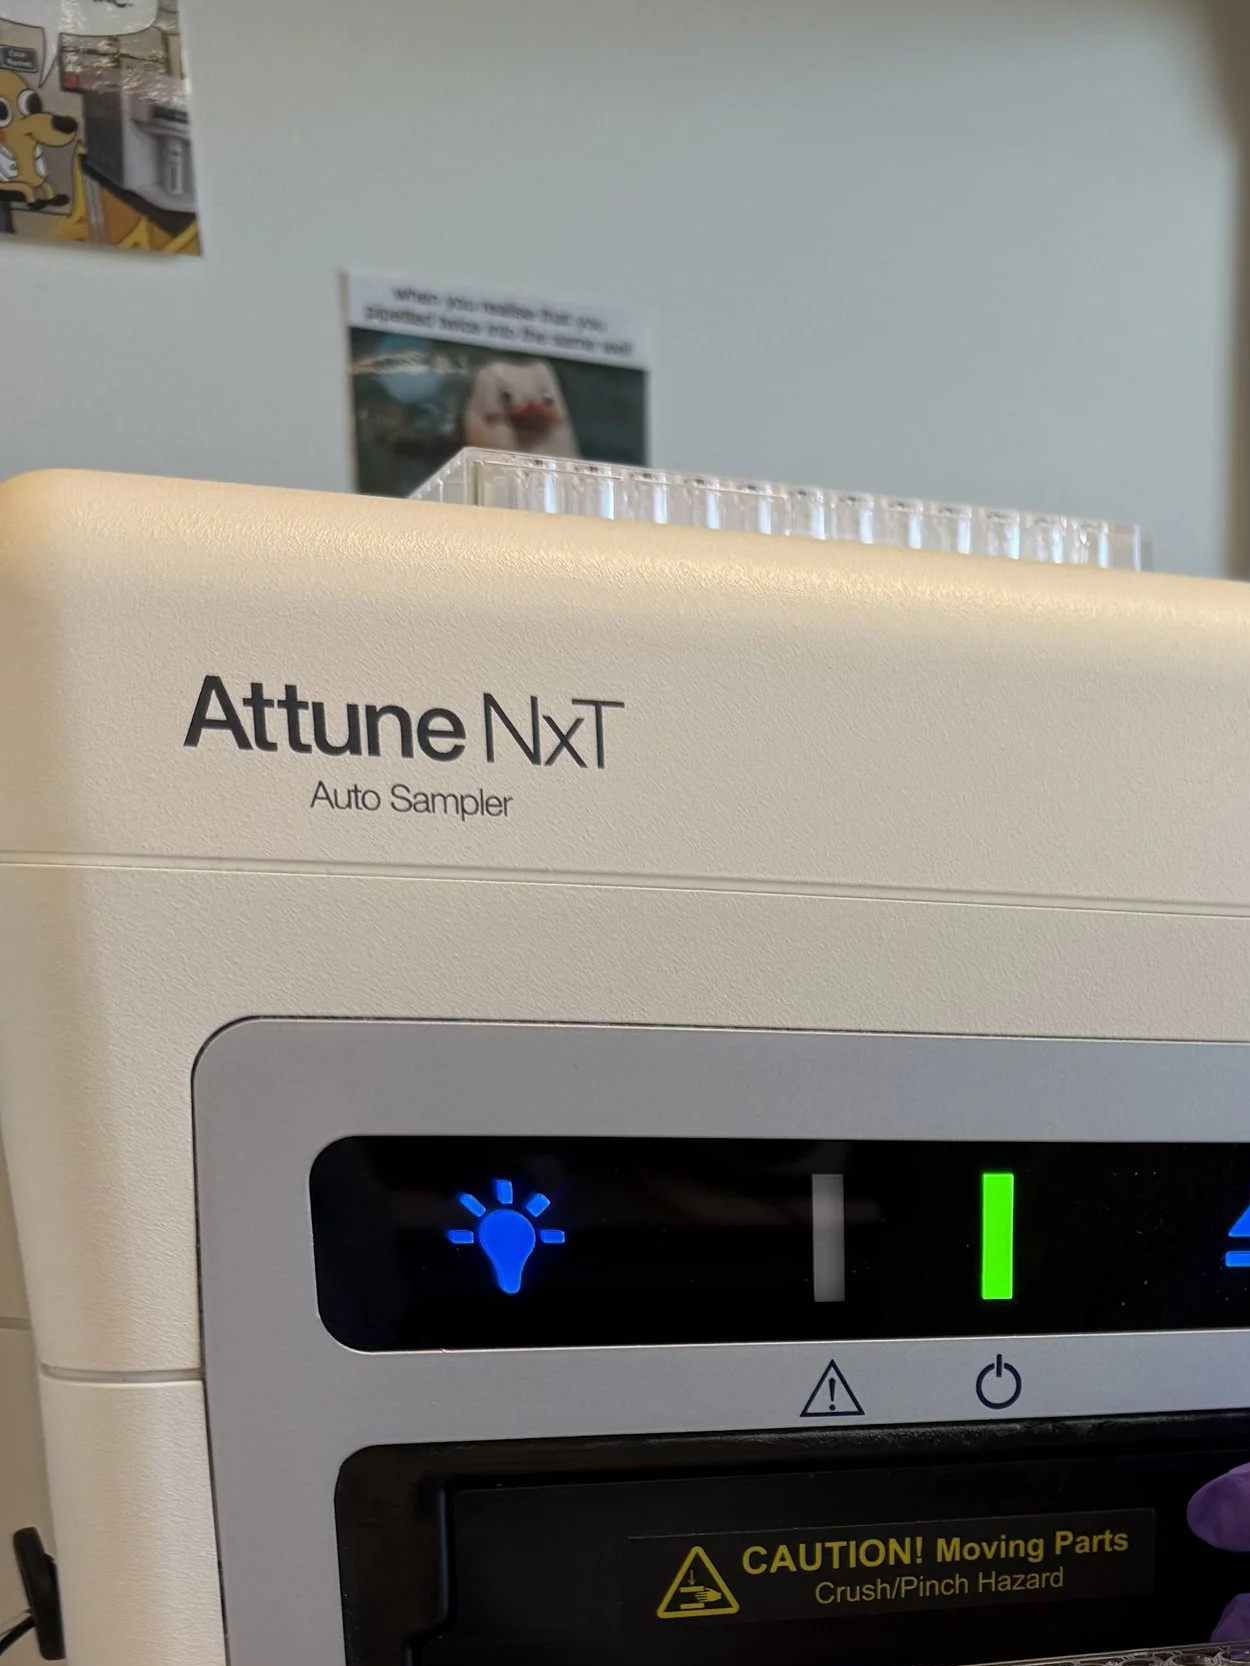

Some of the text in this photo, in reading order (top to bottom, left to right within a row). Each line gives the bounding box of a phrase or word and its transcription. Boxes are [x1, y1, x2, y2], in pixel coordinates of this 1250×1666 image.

[446, 294, 474, 314] you
[183, 675, 625, 769] Attune NxT
[310, 780, 514, 821] Auto Sampler
[742, 1528, 1129, 1575] CAUTION! Moving Parts
[815, 1567, 1064, 1605] Crush/Pinch Hazard
